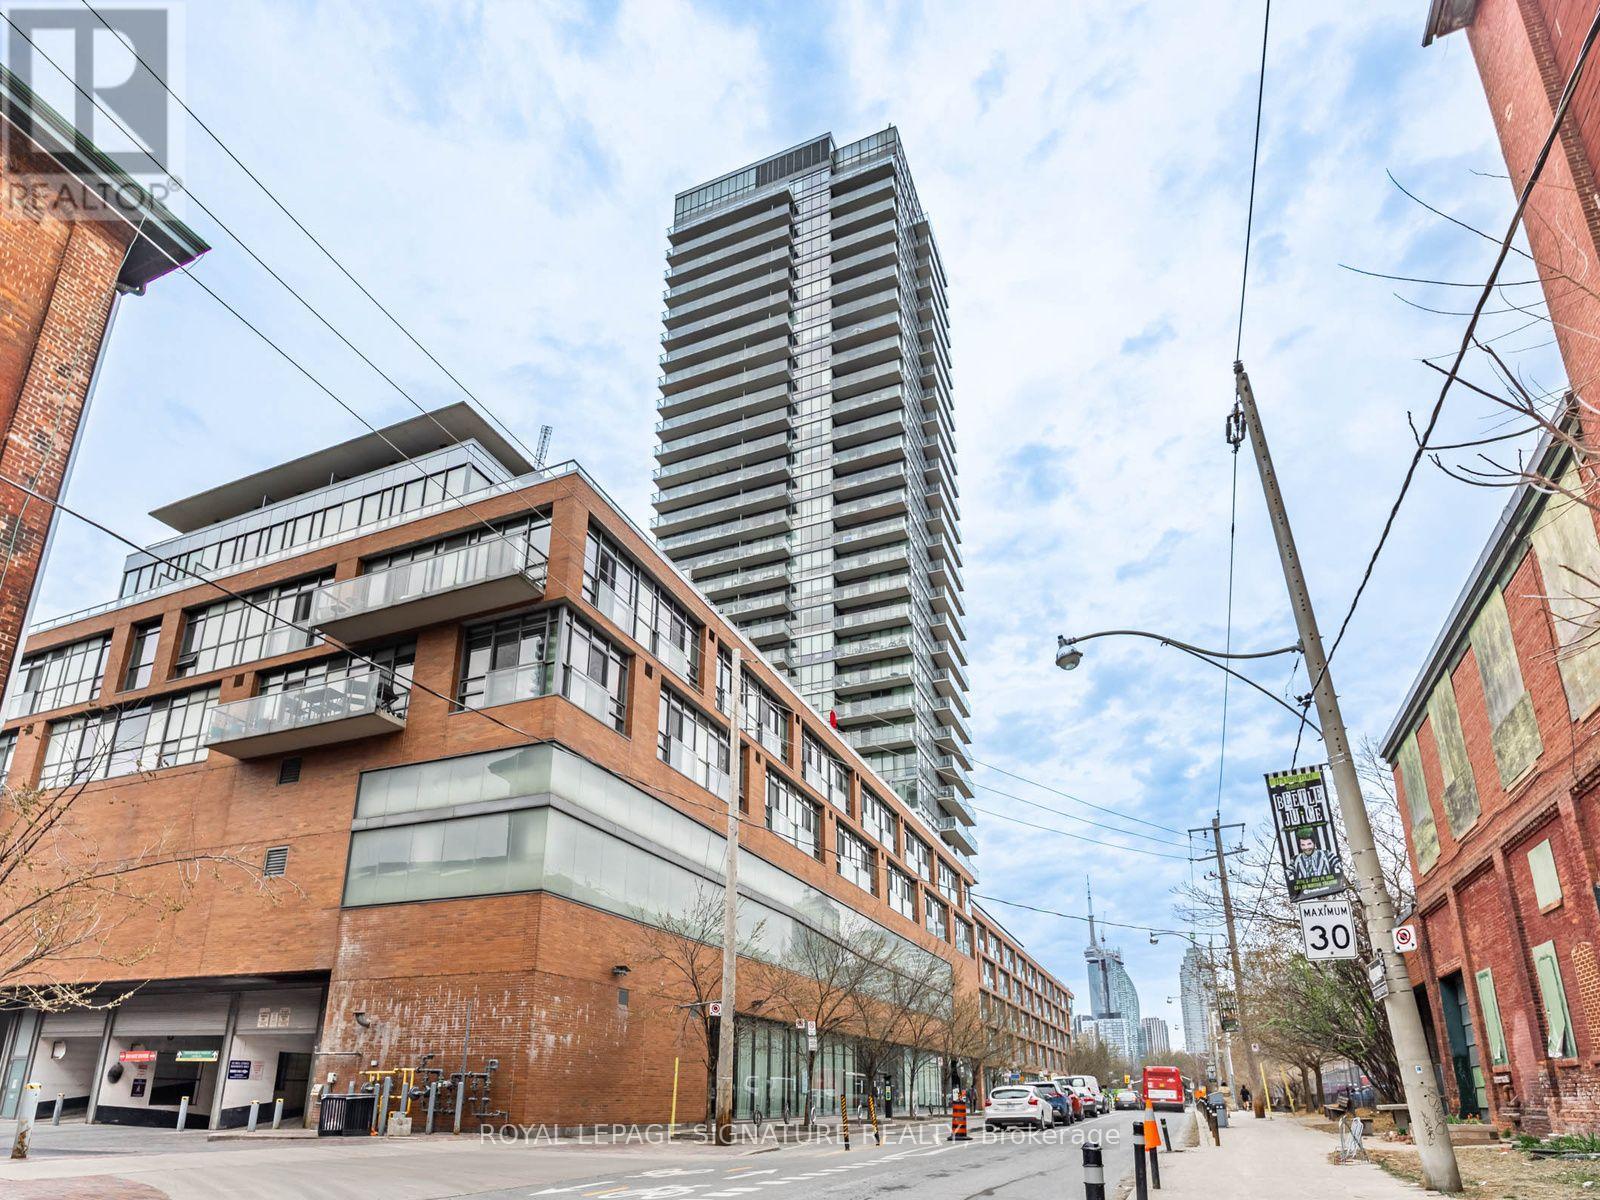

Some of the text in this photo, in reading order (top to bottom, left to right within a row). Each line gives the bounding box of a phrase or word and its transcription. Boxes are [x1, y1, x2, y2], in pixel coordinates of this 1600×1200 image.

[1276, 786, 1323, 810] BEETLE
[1303, 906, 1348, 917] MAXIMUM
[1310, 924, 1350, 951] 30
